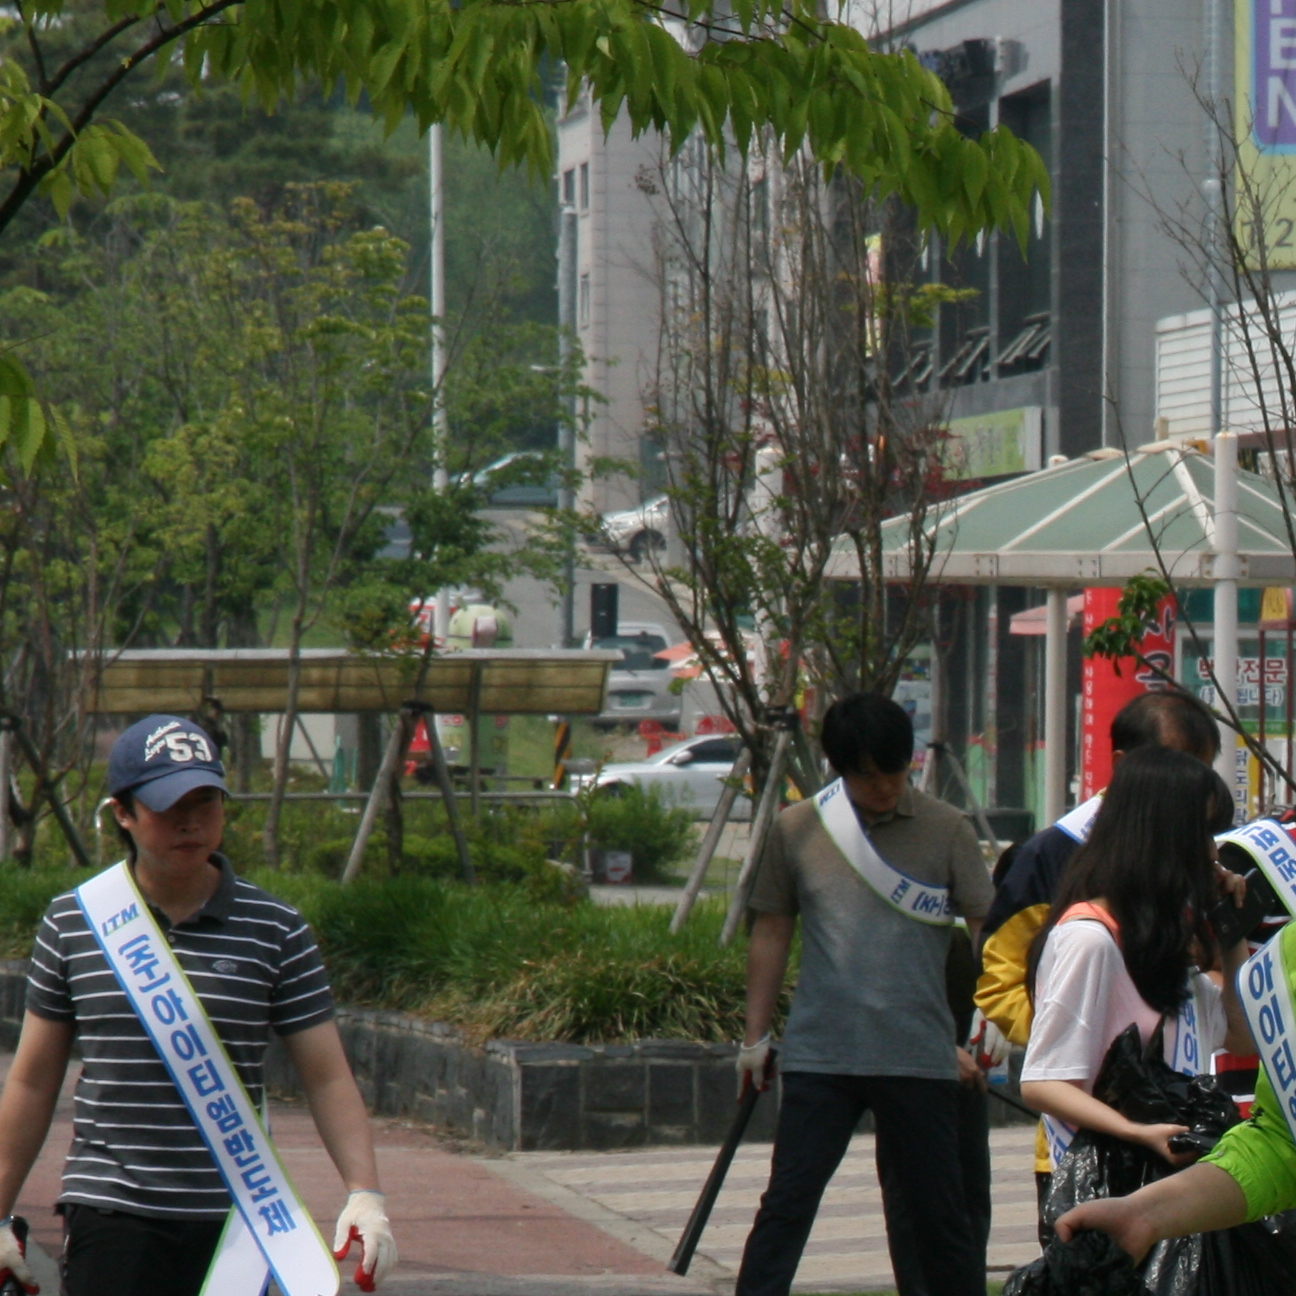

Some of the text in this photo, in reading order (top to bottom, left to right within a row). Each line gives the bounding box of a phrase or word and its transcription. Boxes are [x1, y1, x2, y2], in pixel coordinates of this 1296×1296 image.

[164, 731, 213, 763] 53
[889, 878, 913, 905] ITM
[102, 902, 141, 938] ITM
[117, 933, 298, 1237] (주)아이티엠반도체
